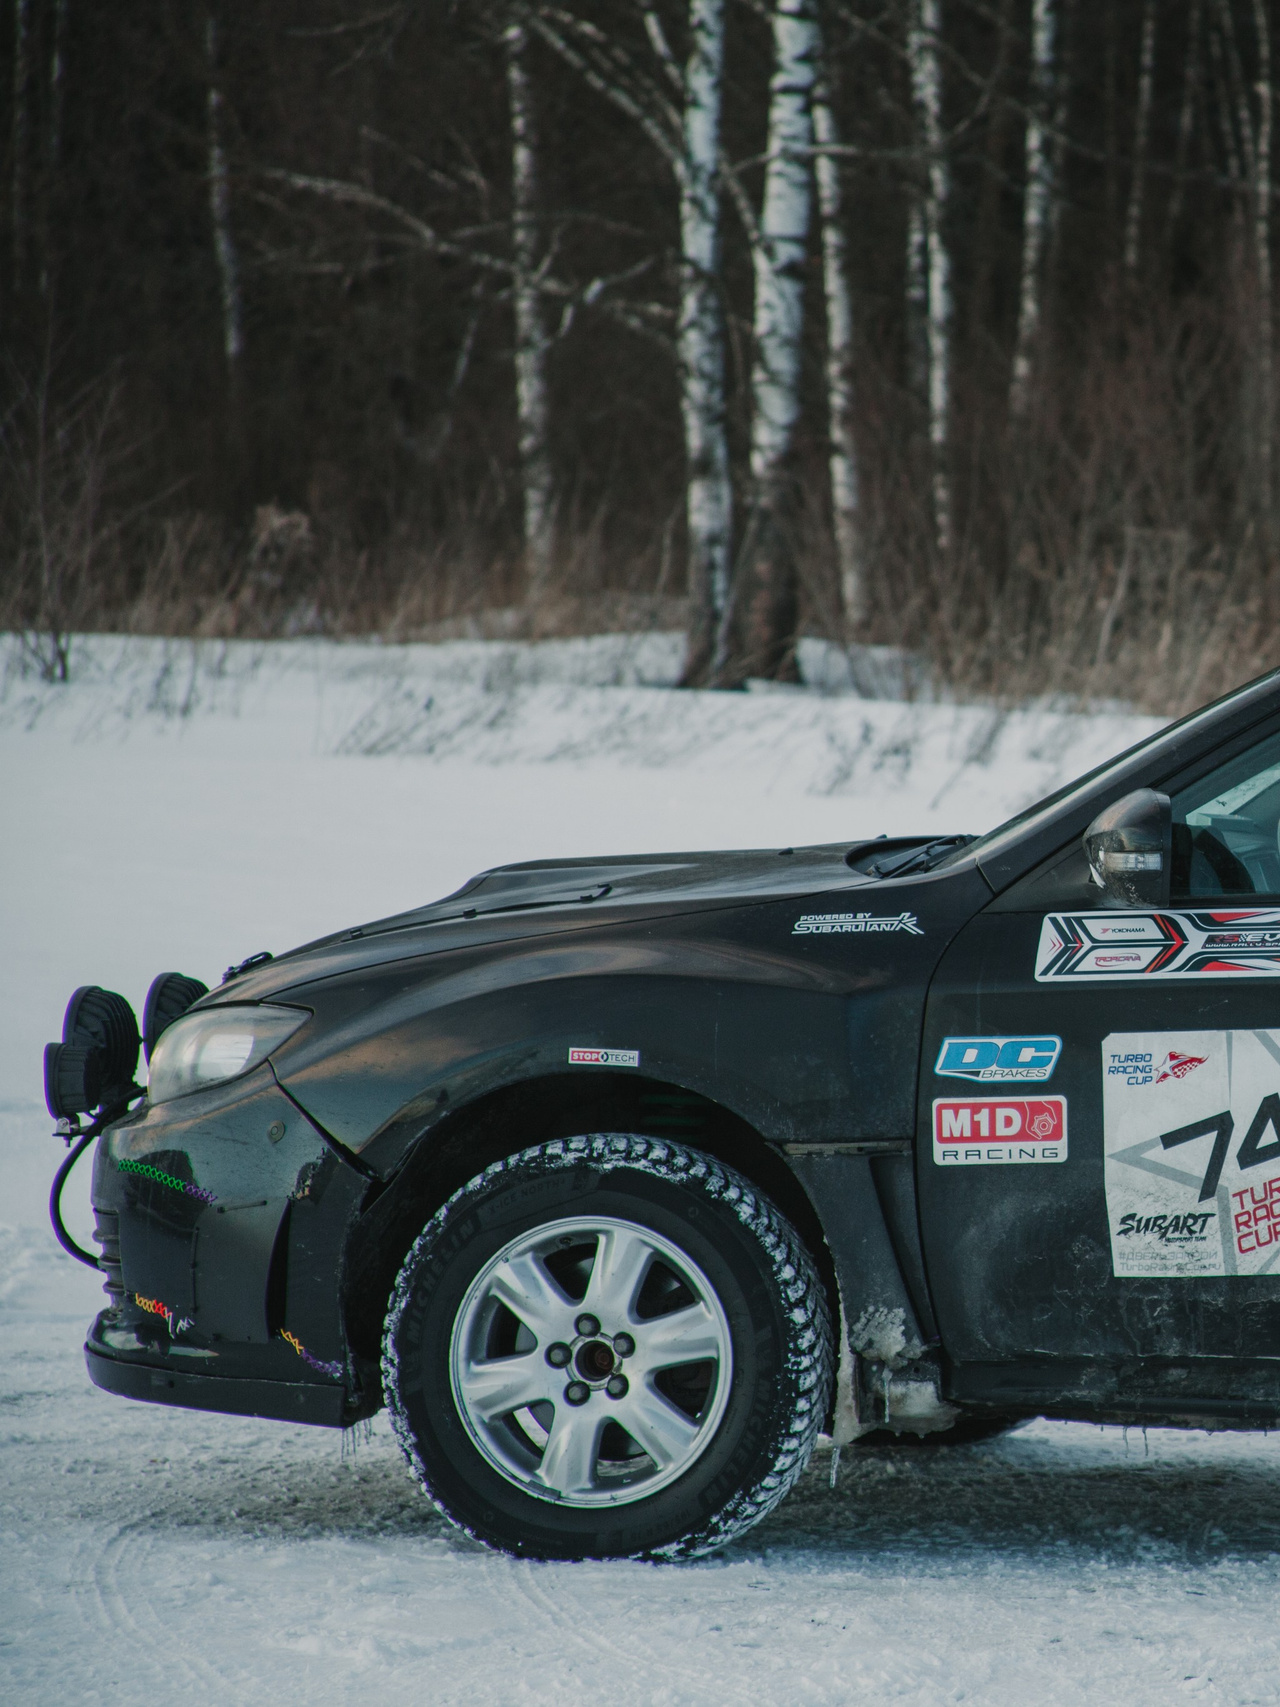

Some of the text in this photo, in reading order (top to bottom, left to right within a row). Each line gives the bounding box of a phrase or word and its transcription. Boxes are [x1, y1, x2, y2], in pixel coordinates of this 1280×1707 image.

[800, 913, 853, 922] POWERED
[939, 1040, 1057, 1070] DC
[1110, 1053, 1152, 1064] TURBO
[981, 1068, 1048, 1078] BRAKES
[1108, 1065, 1153, 1075] RACING
[1127, 1075, 1153, 1086] CUP
[941, 1107, 1022, 1137] M1D
[942, 1148, 1058, 1161] RACING
[1116, 1213, 1216, 1240] SUBART
